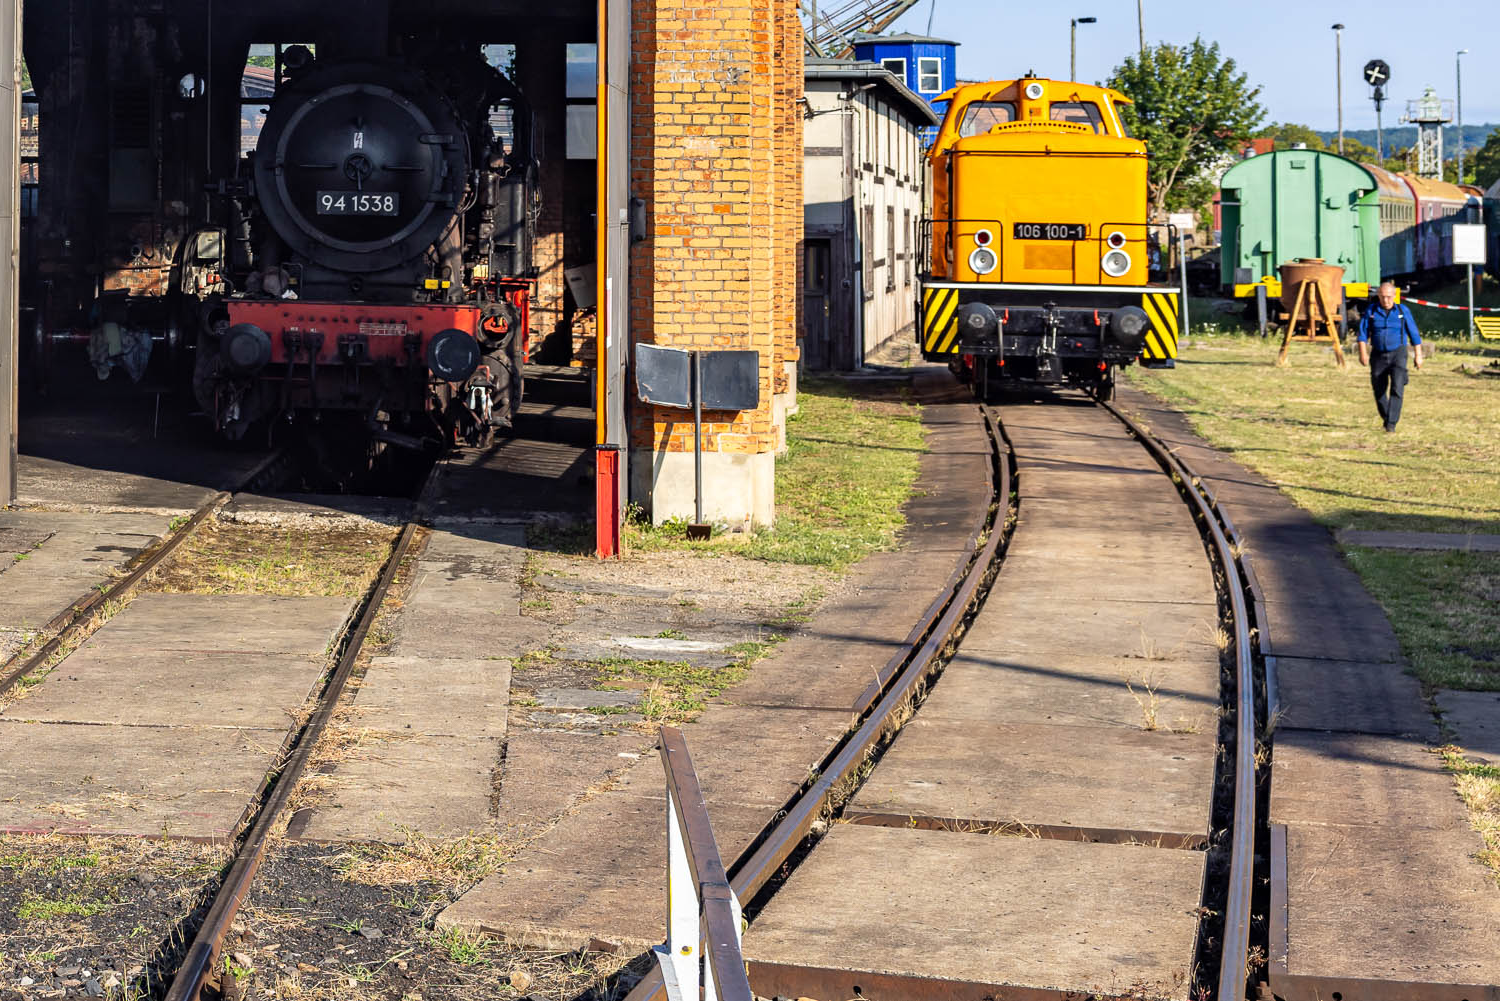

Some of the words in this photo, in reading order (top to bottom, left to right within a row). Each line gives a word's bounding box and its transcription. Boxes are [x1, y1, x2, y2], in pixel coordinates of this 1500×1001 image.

[321, 194, 346, 211] 94
[351, 195, 394, 212] 1538
[1017, 224, 1041, 238] 106
[1044, 225, 1083, 239] 100-1
